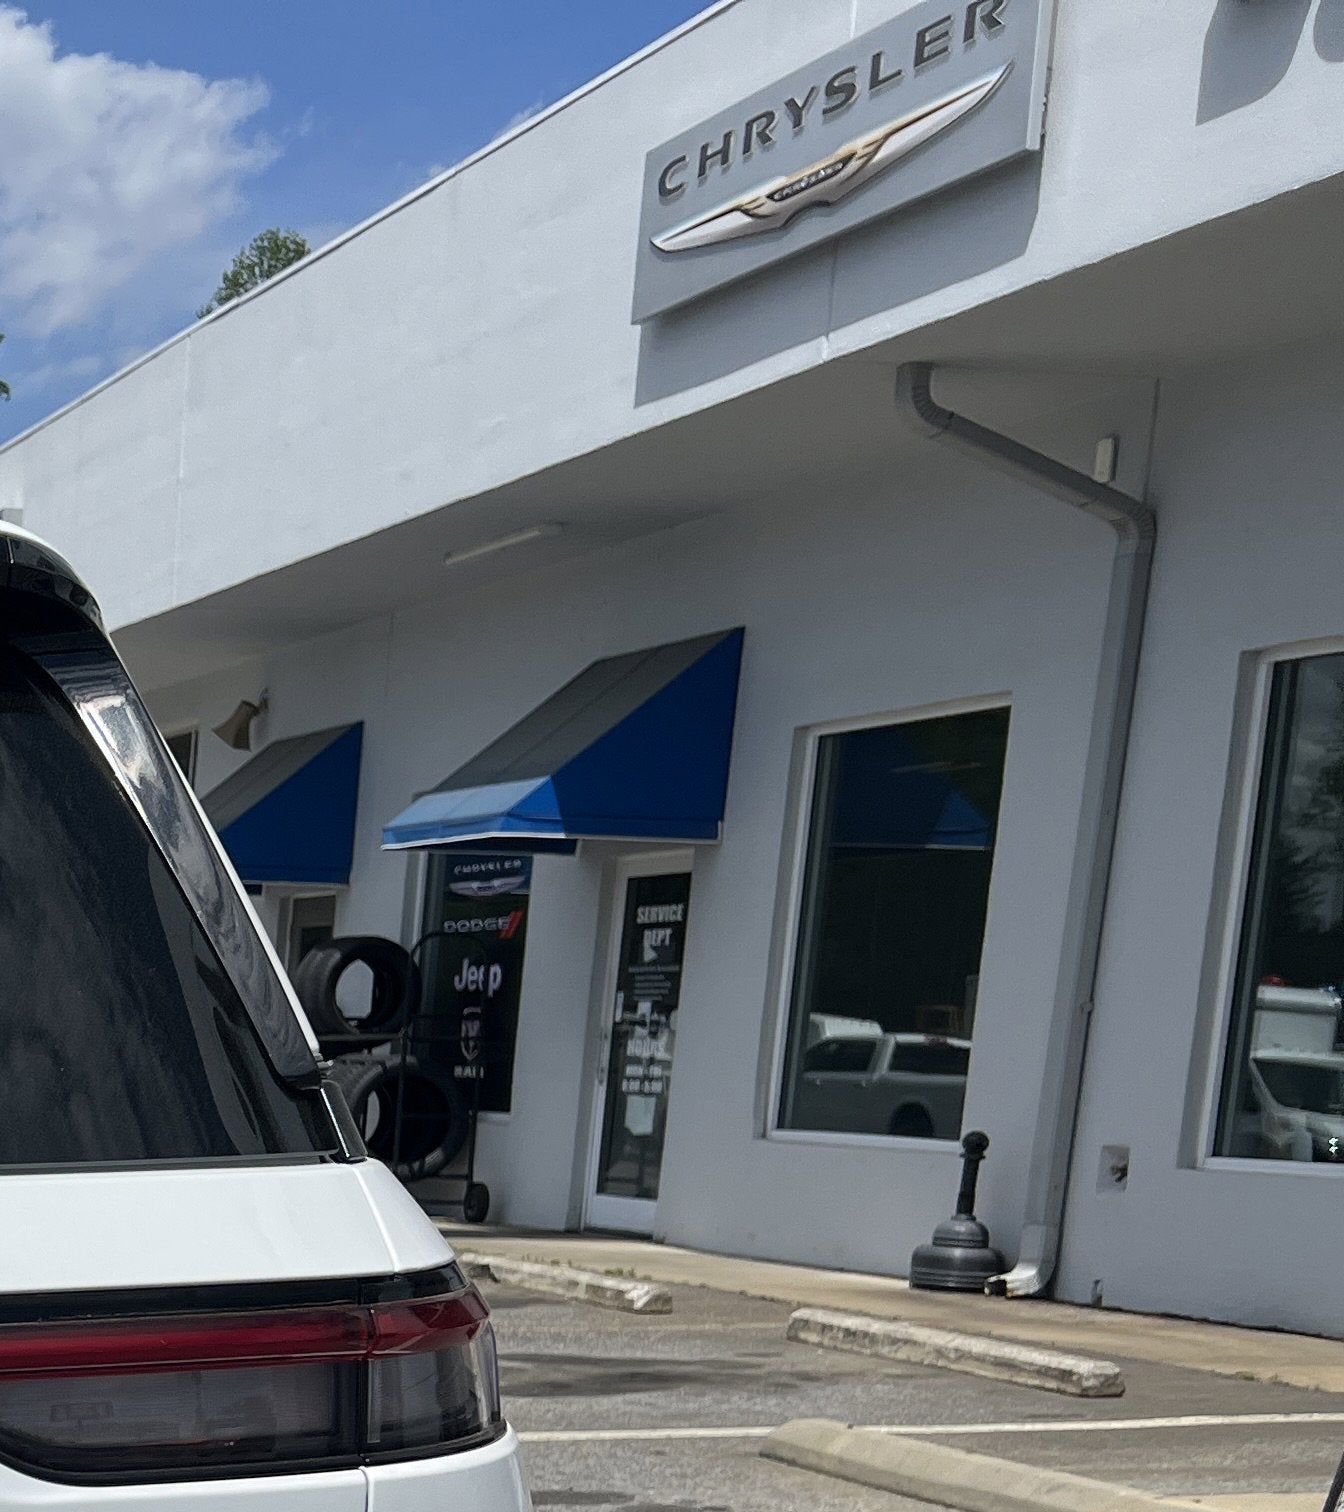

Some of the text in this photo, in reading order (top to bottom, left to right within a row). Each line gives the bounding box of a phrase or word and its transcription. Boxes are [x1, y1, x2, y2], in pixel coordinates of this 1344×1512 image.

[658, 0, 1008, 197] CHRYSLER
[636, 903, 684, 924] SERVICE
[443, 916, 510, 934] DODGE
